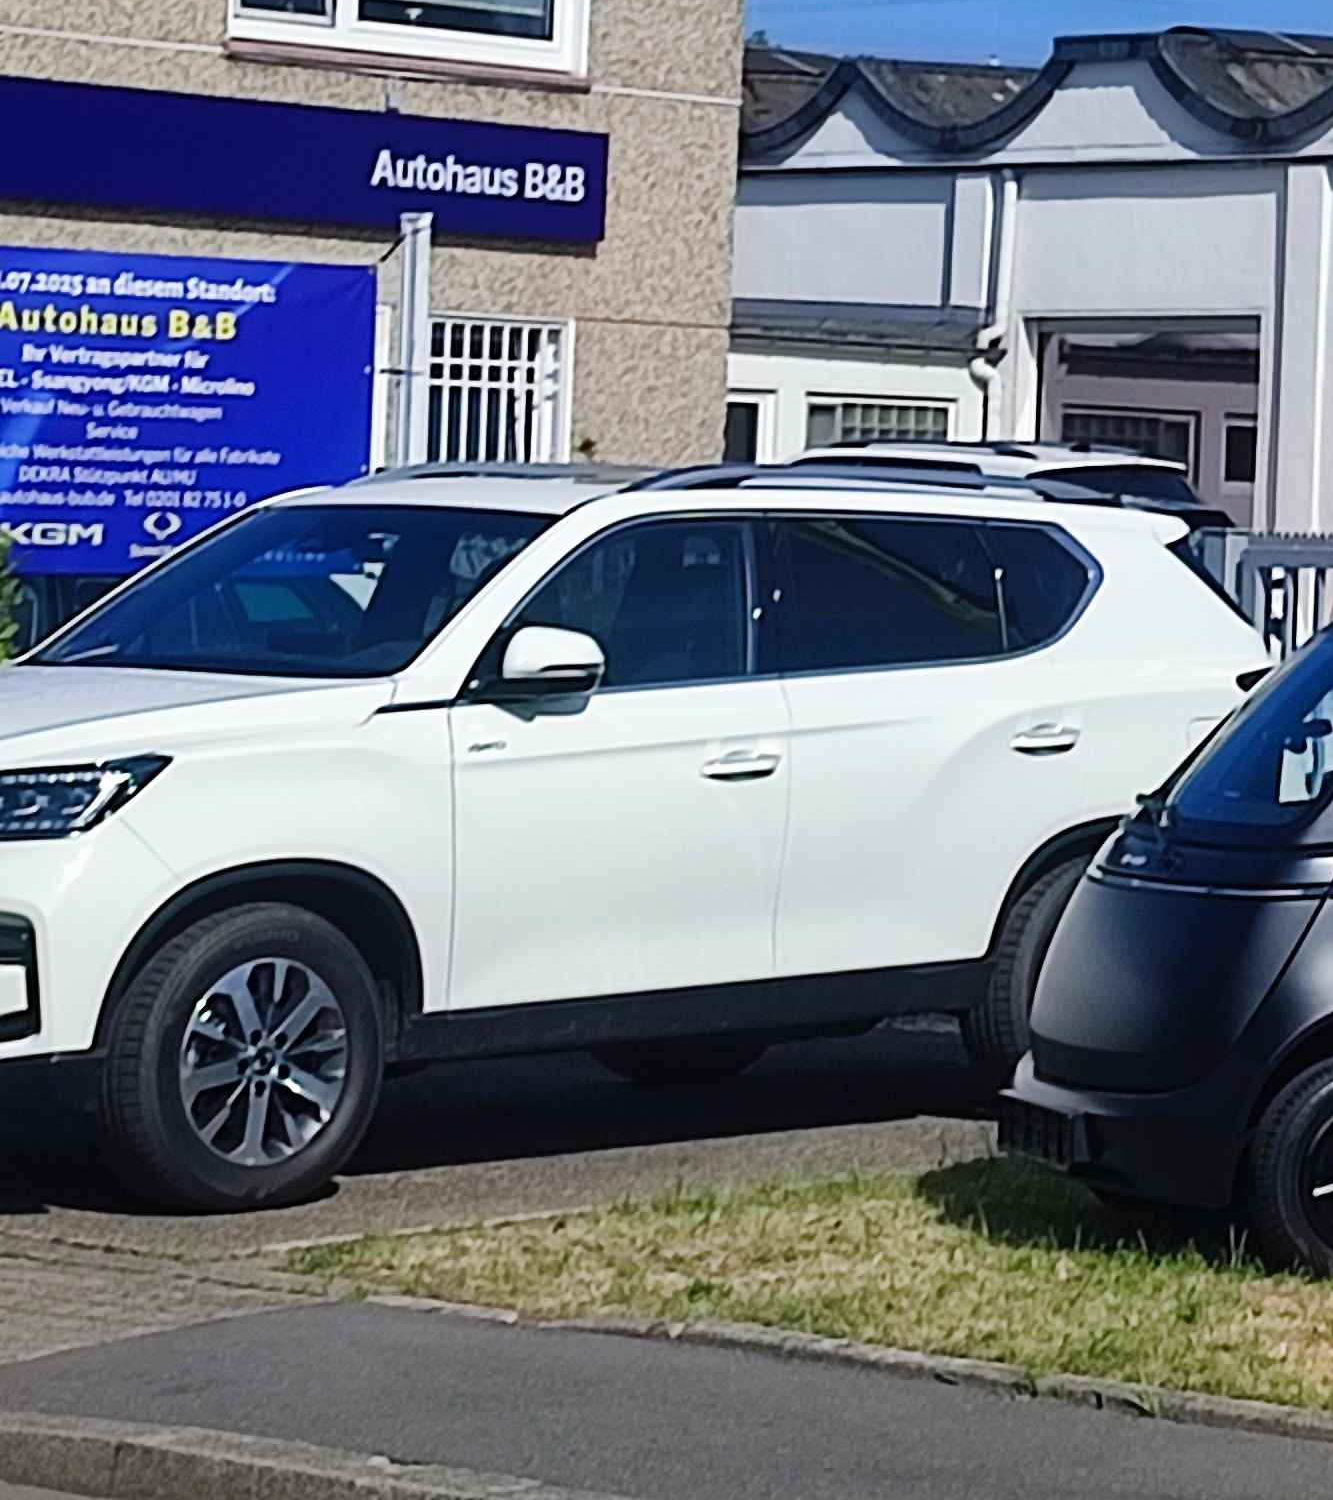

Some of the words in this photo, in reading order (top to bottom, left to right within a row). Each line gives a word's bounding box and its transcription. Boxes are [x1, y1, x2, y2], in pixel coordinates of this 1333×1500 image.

[370, 149, 519, 197] Autohaus
[523, 162, 585, 202] B&B
[0, 270, 84, 296] .07.2025
[113, 271, 184, 298] diesem
[186, 276, 276, 303] Standort:
[0, 301, 158, 338] Autohaus
[168, 308, 237, 340] B&B
[86, 421, 139, 440] Service
[0, 521, 105, 547] KGM
